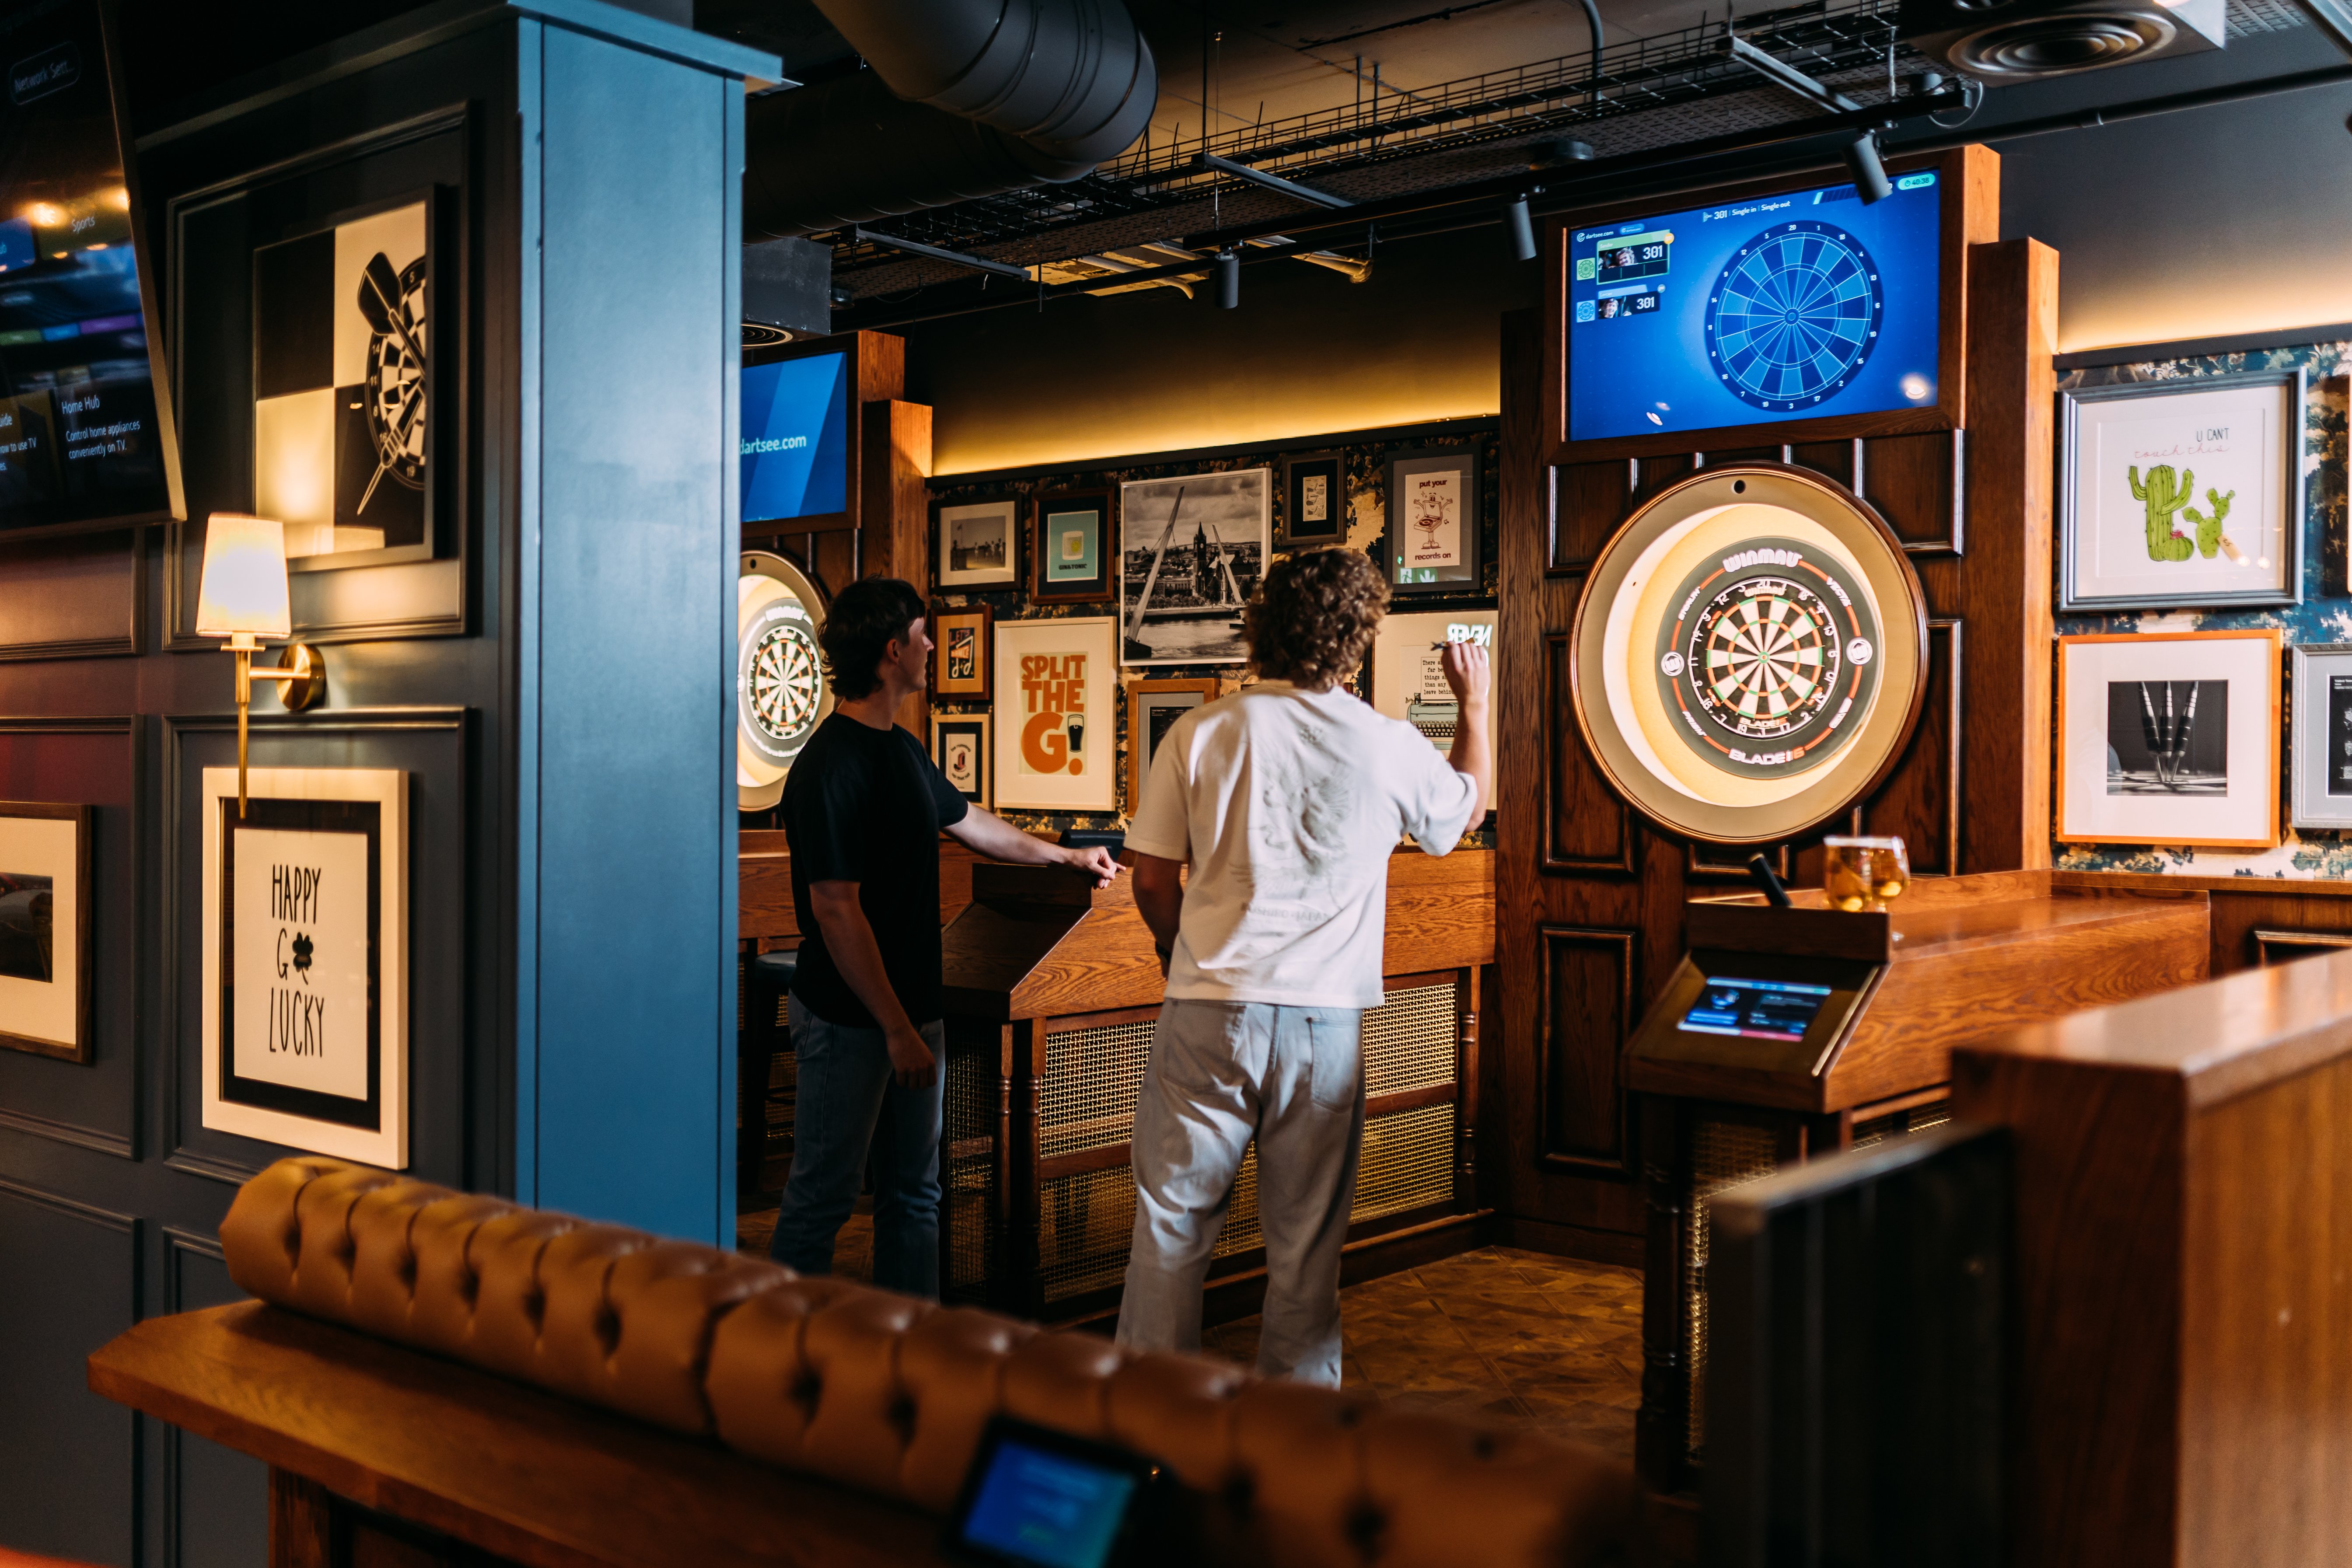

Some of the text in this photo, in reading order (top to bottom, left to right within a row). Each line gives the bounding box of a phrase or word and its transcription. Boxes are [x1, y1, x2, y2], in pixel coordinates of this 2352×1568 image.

[1714, 210, 1727, 220] 301
[1732, 207, 1750, 216] Single
[1761, 203, 1779, 211] Single
[71, 217, 95, 234] Sports
[1586, 231, 1614, 239] dartsee.com
[1643, 245, 1663, 259] 301
[1637, 297, 1655, 309] 301
[61, 395, 100, 415] Home Hub
[66, 421, 140, 442] Control home appliances
[2197, 428, 2229, 442] U CAN'T
[10, 443, 17, 451] to
[18, 441, 28, 450] use
[28, 437, 37, 448] TV
[69, 439, 127, 459] conveniently on TV.
[739, 436, 807, 454] dartsee.com
[2135, 443, 2230, 458] touch this
[1419, 480, 1430, 489] put
[1723, 548, 1800, 573] WINMAU
[1021, 655, 1086, 681] SPLIT
[1022, 680, 1084, 712] THE
[272, 864, 321, 924] HAPPY
[269, 987, 324, 1058] LUCKY
